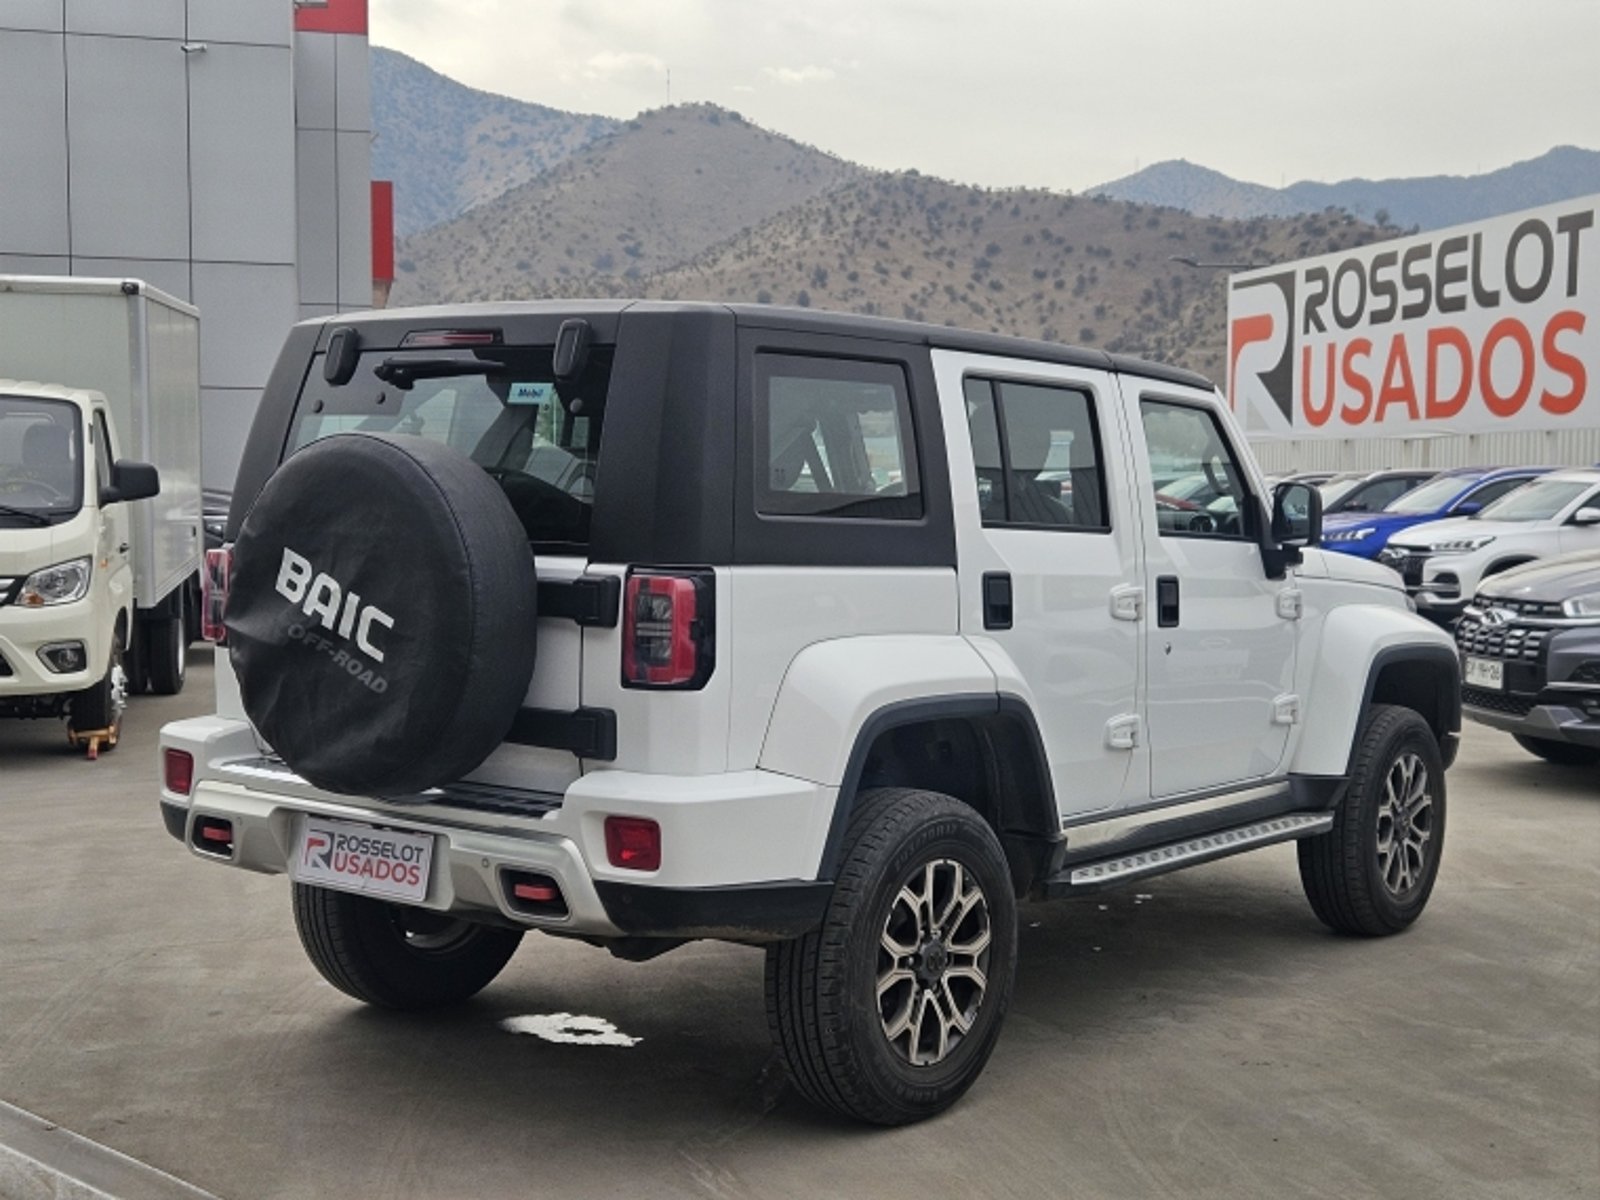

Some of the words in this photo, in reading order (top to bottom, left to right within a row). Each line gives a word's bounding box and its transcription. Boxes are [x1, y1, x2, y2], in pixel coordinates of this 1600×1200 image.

[1303, 209, 1595, 335] ROSSELOT
[1302, 310, 1587, 427] USADOS
[275, 546, 395, 664] BAIC
[287, 623, 389, 694] OFF-ROAD
[334, 852, 421, 886] USADOS
[336, 833, 424, 863] ROSSELOT
